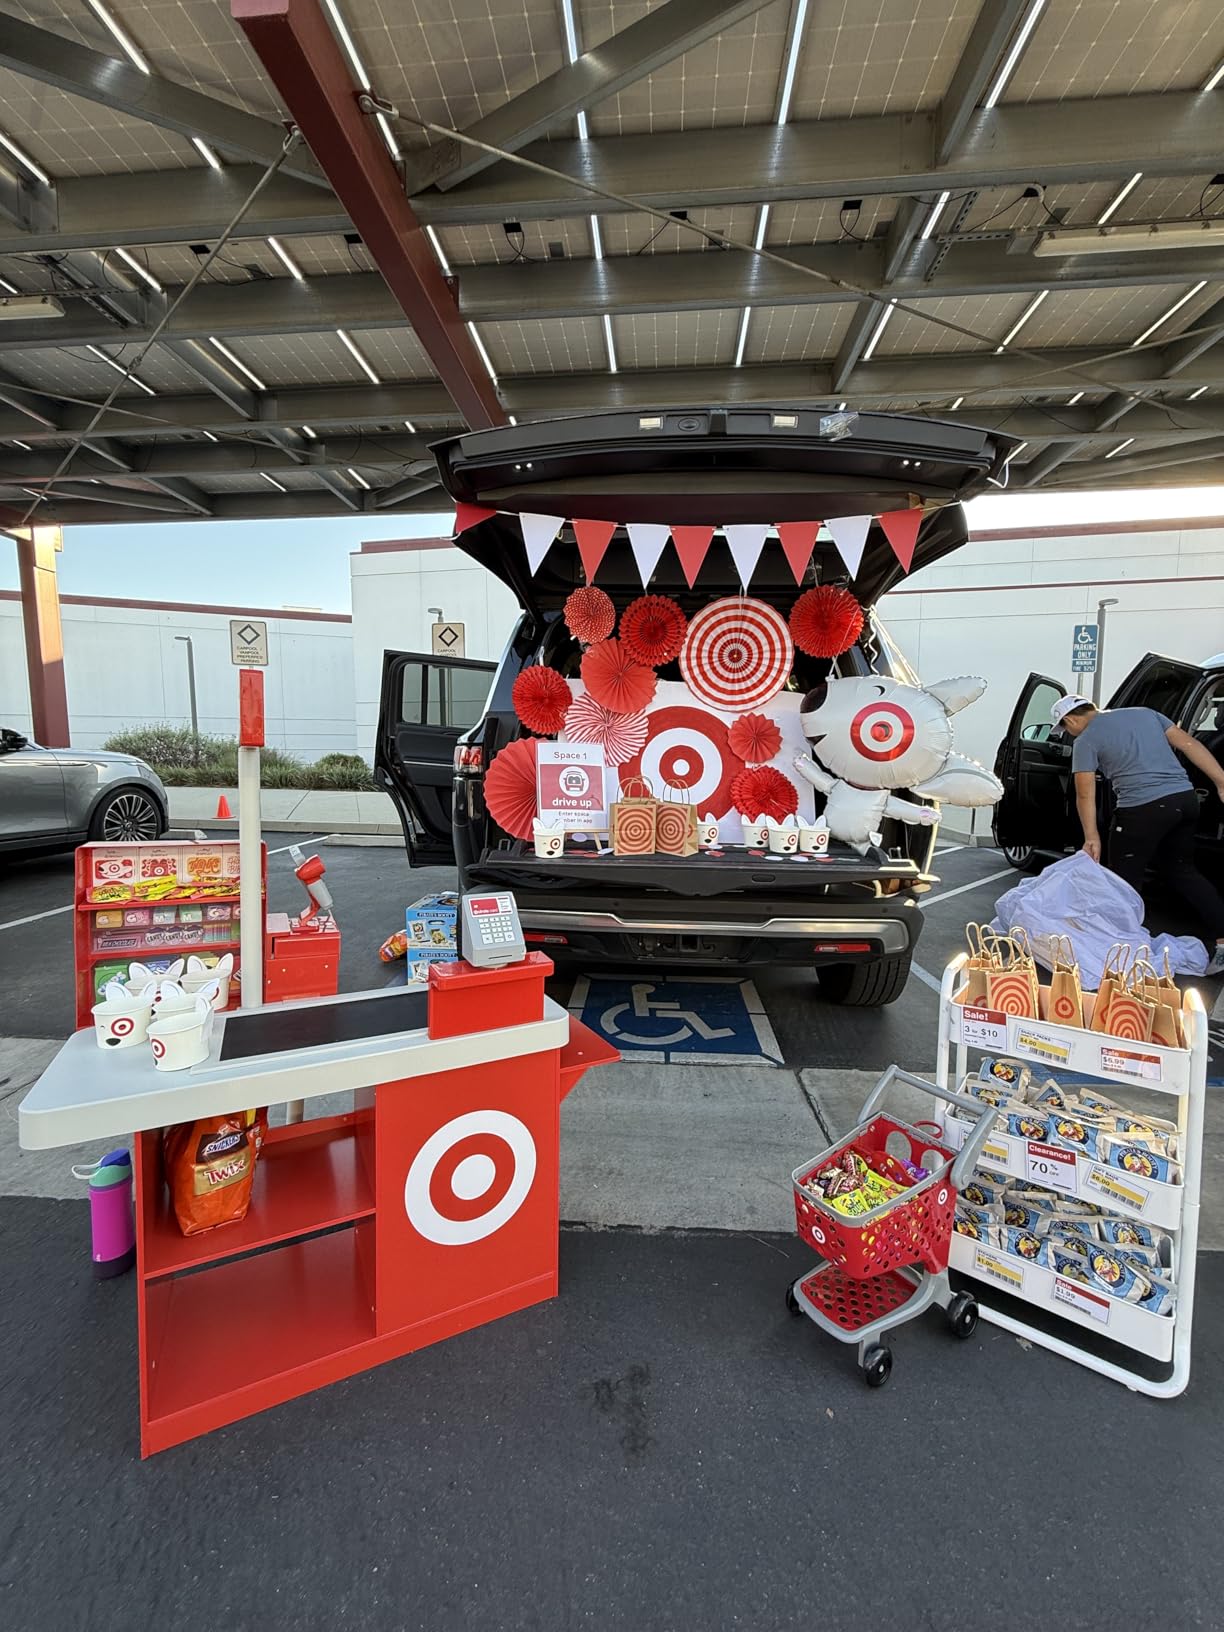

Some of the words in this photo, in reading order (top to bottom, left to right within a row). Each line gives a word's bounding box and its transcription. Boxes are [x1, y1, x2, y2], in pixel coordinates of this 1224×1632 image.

[1073, 643, 1096, 651] PARKING
[553, 751, 580, 760] Space
[582, 752, 587, 760] 1
[552, 797, 578, 806] drive
[580, 800, 592, 809] up
[964, 1010, 989, 1021] Sale!
[964, 1025, 970, 1033] 3
[980, 1028, 998, 1038] $10
[1020, 1037, 1037, 1047] $4.00
[1102, 1048, 1120, 1057] Sale
[206, 1135, 239, 1152] SNICKERS
[1029, 1144, 1072, 1161] Clearance!
[1029, 1159, 1048, 1174] 70
[1091, 1173, 1110, 1187] $6.00
[977, 1256, 993, 1268] $1.00
[1056, 1279, 1073, 1290] Sale
